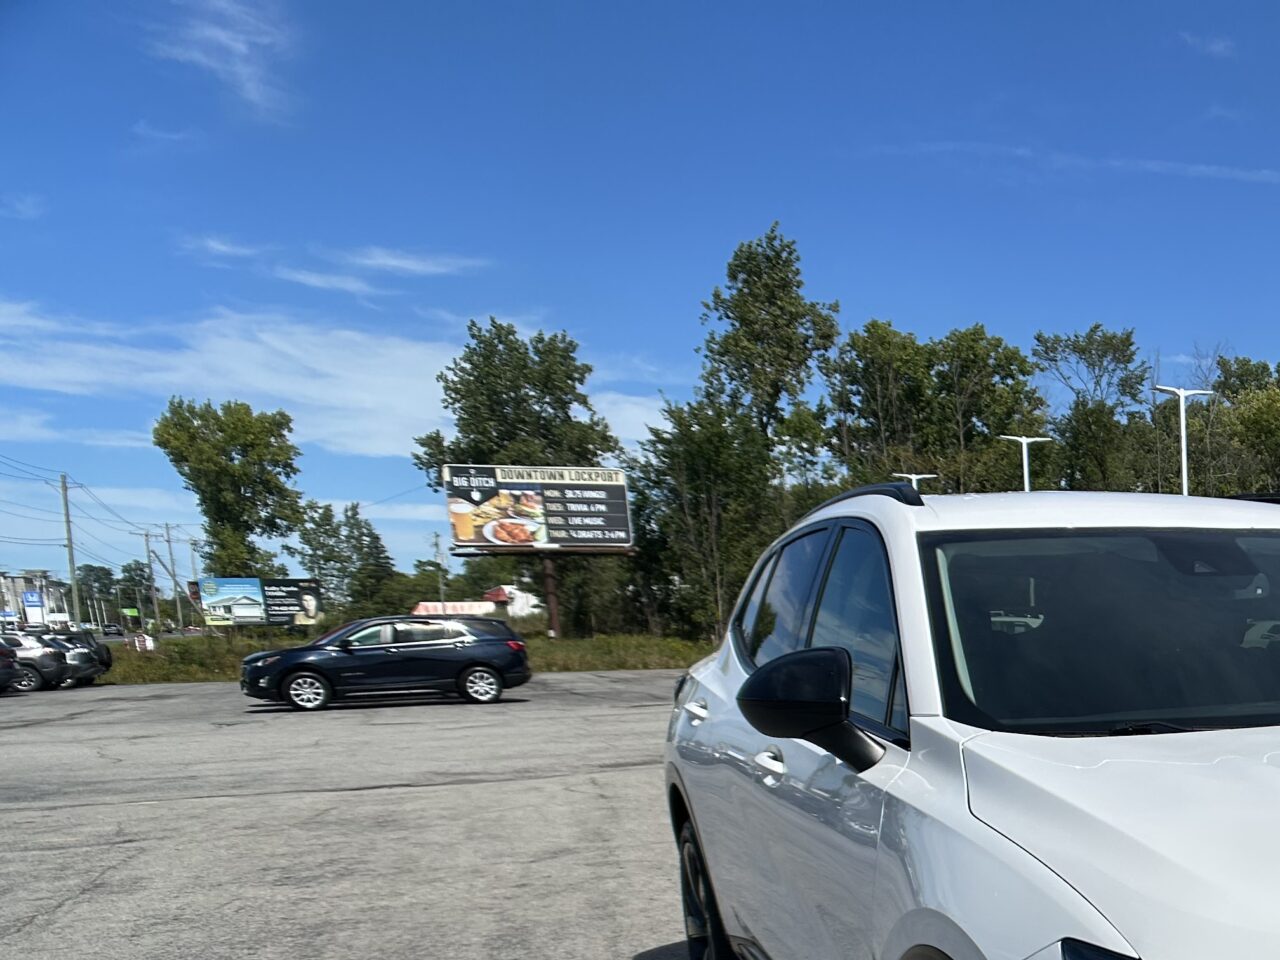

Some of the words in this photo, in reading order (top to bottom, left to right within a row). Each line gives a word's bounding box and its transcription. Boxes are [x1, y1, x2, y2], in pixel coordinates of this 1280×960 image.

[501, 468, 565, 481] DOWNTOWN
[568, 470, 620, 482] LOCKPORT
[452, 476, 469, 487] BIG
[469, 476, 496, 487] DITCH
